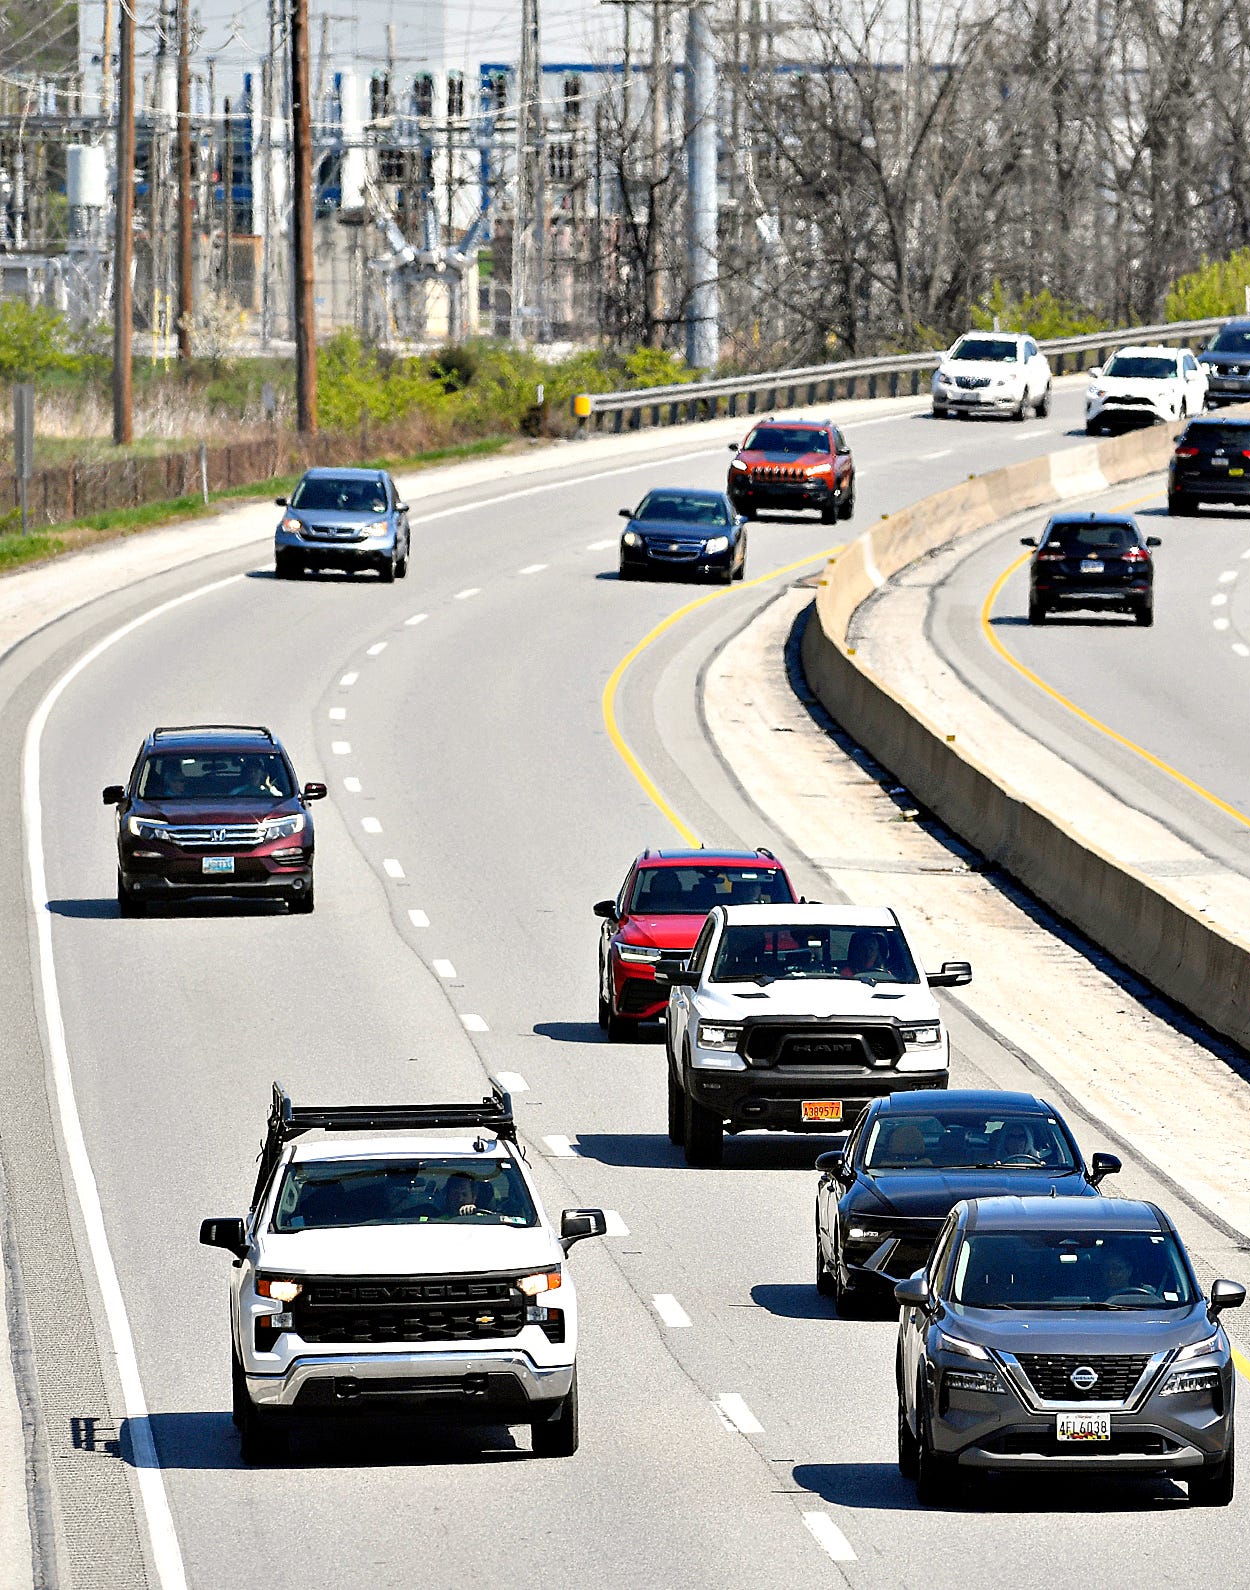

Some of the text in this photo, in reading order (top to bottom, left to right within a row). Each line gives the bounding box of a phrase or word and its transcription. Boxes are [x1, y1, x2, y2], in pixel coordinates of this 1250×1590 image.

[793, 1043, 852, 1052] RAM
[803, 1107, 840, 1117] A389577
[317, 1284, 509, 1298] CHEVROLET
